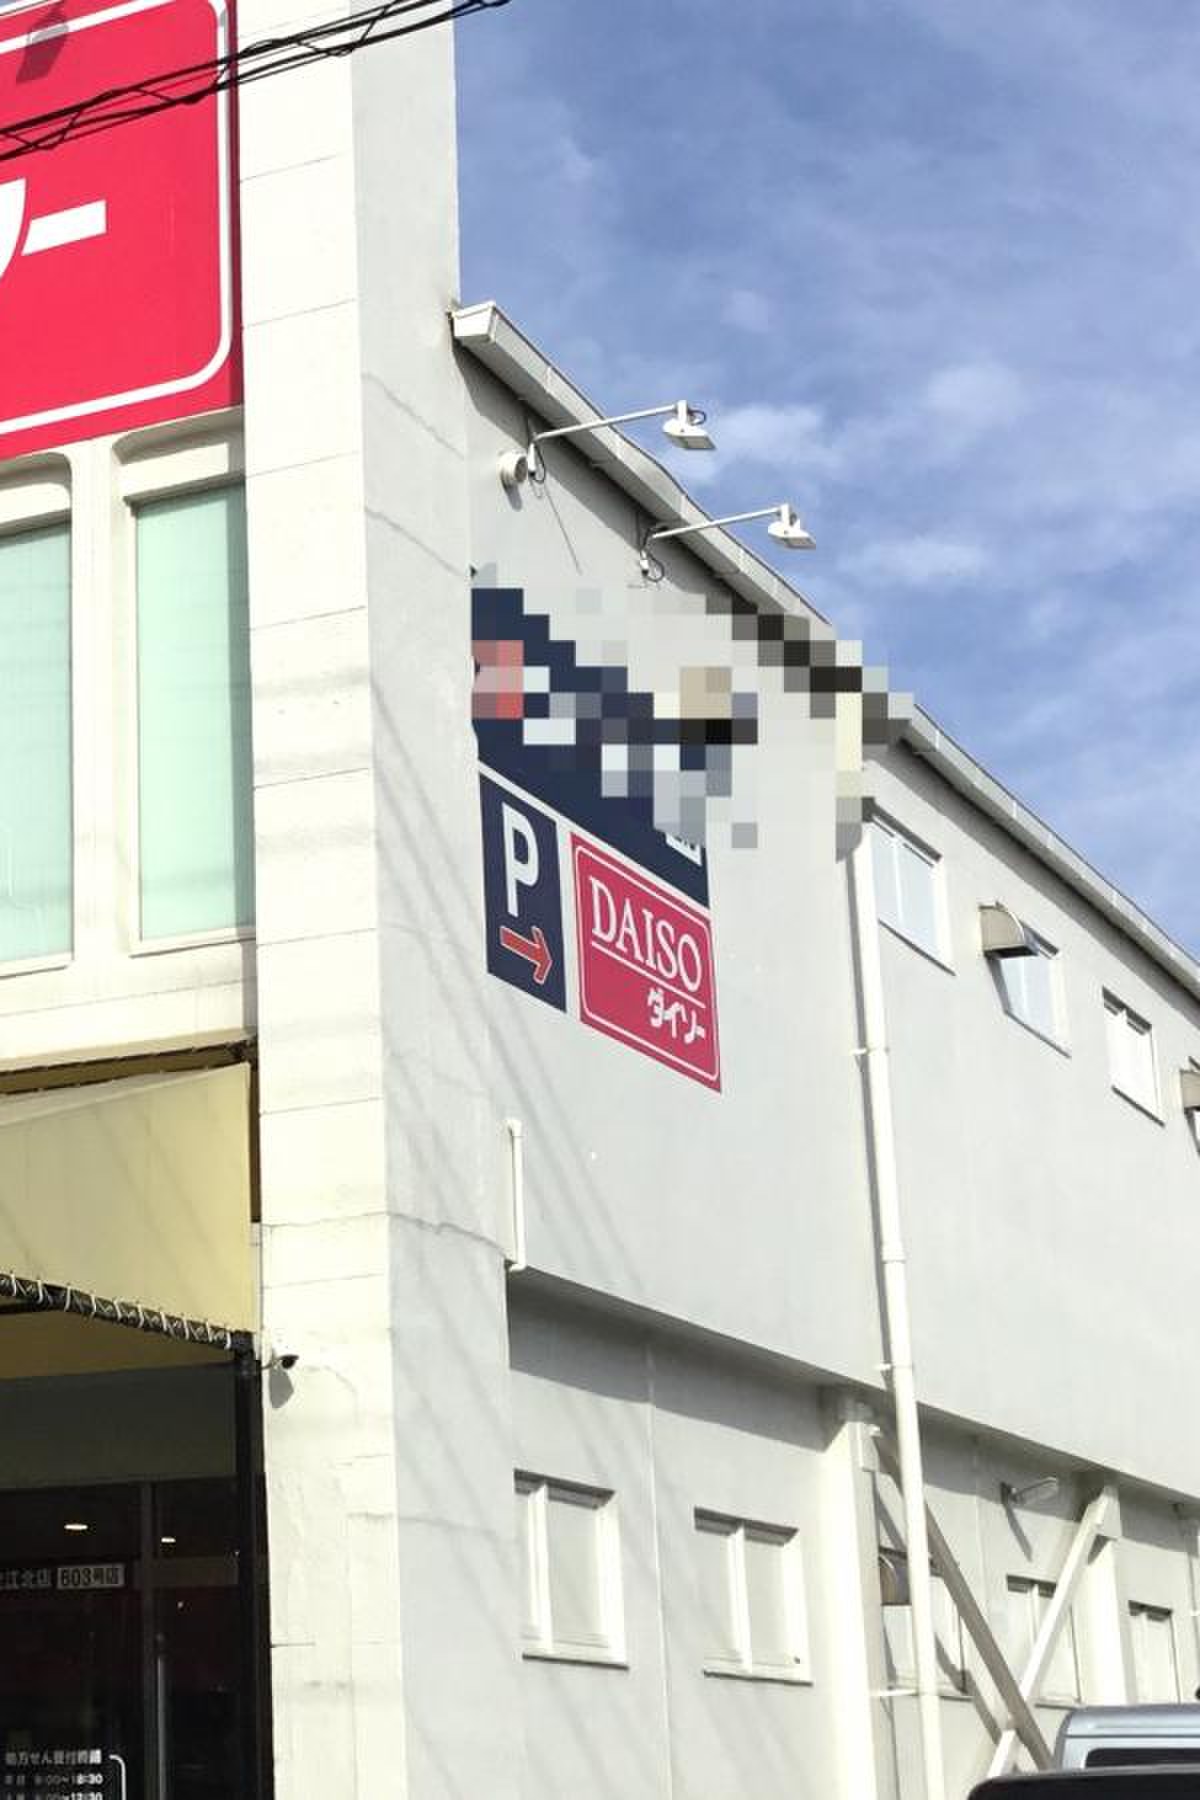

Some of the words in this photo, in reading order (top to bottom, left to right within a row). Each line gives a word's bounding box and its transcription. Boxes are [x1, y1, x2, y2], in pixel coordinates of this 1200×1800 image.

[501, 801, 539, 918] P
[590, 877, 702, 992] DAISO
[647, 989, 705, 1043] ダイソー
